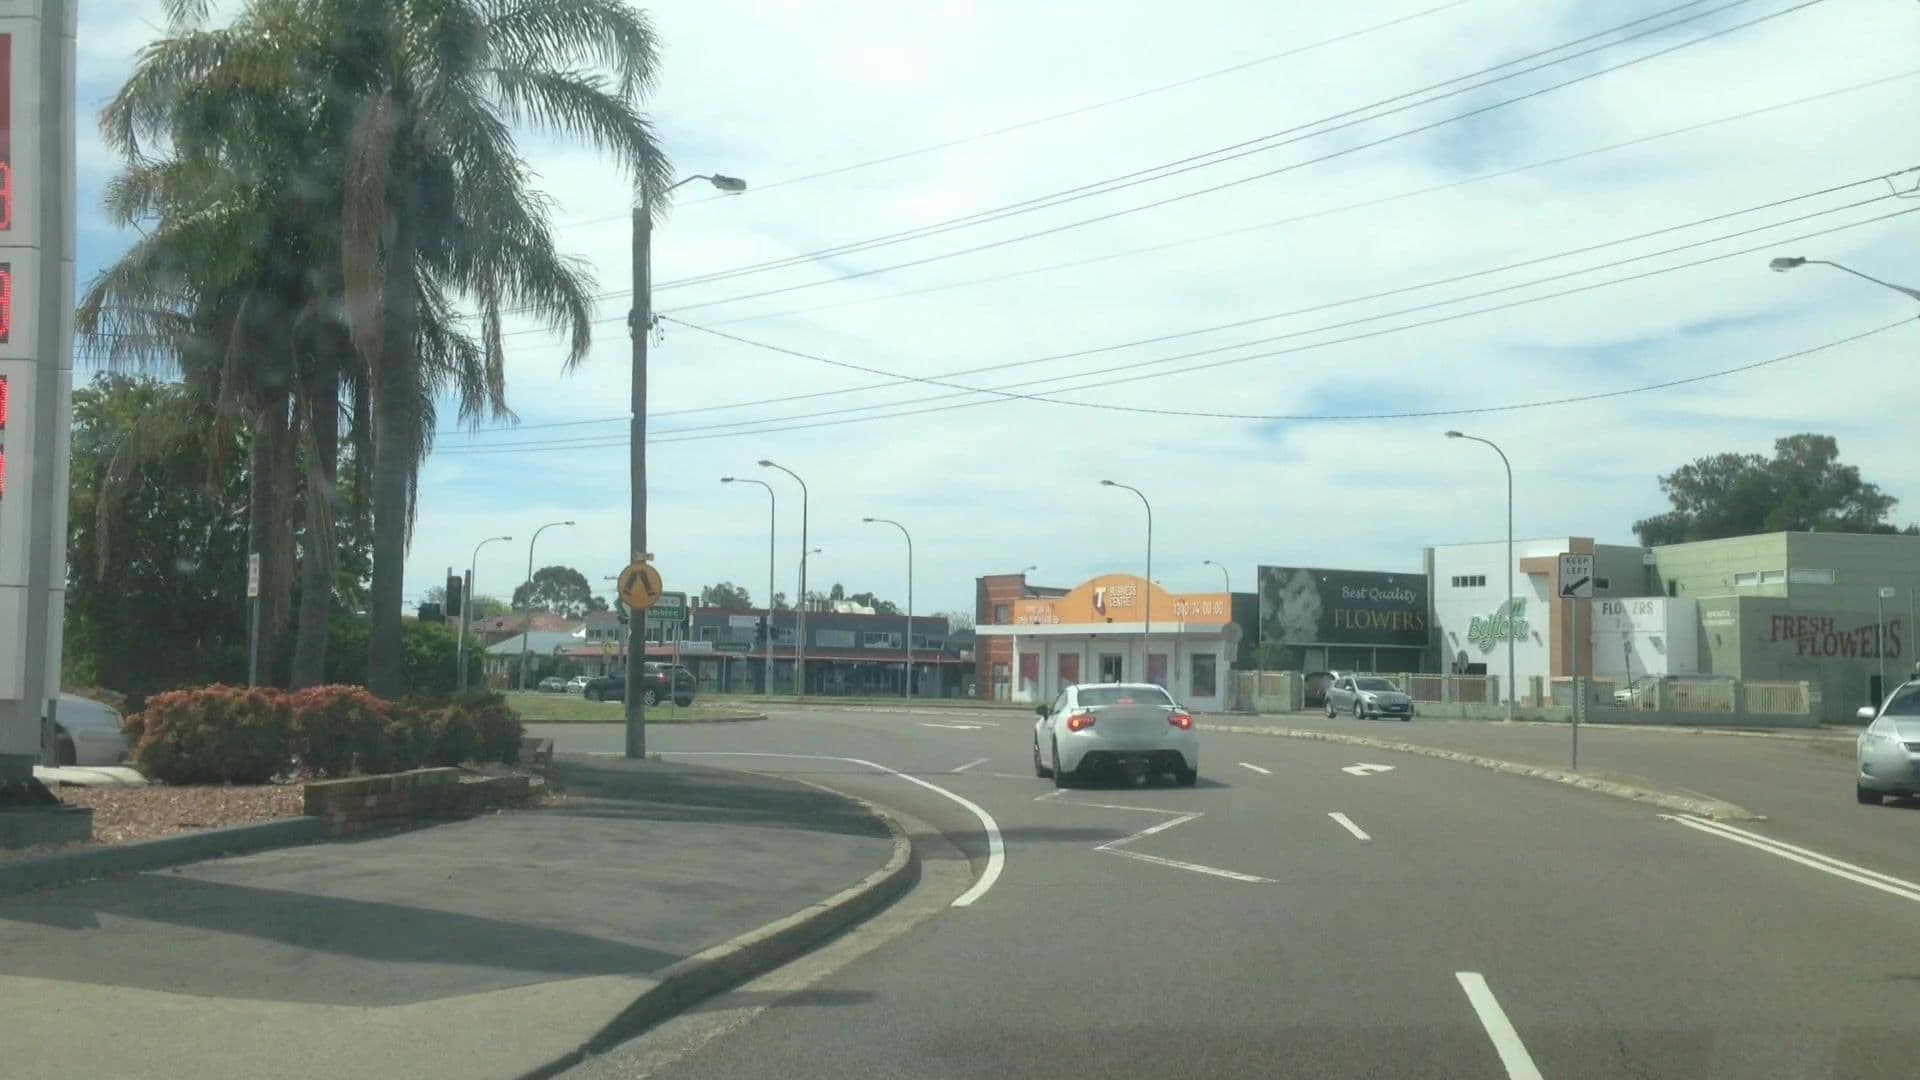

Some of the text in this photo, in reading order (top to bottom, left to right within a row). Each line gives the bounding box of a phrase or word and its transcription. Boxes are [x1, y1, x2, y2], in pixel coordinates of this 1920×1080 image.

[1566, 557, 1588, 565] KEEP
[1566, 567, 1588, 575] LEFT
[1341, 586, 1417, 604] Best Quality
[1602, 601, 1655, 616] FLOERS
[1334, 608, 1424, 631] FLOWERS
[1770, 615, 1834, 642] FRESH
[1797, 619, 1902, 658] FLOWERS
